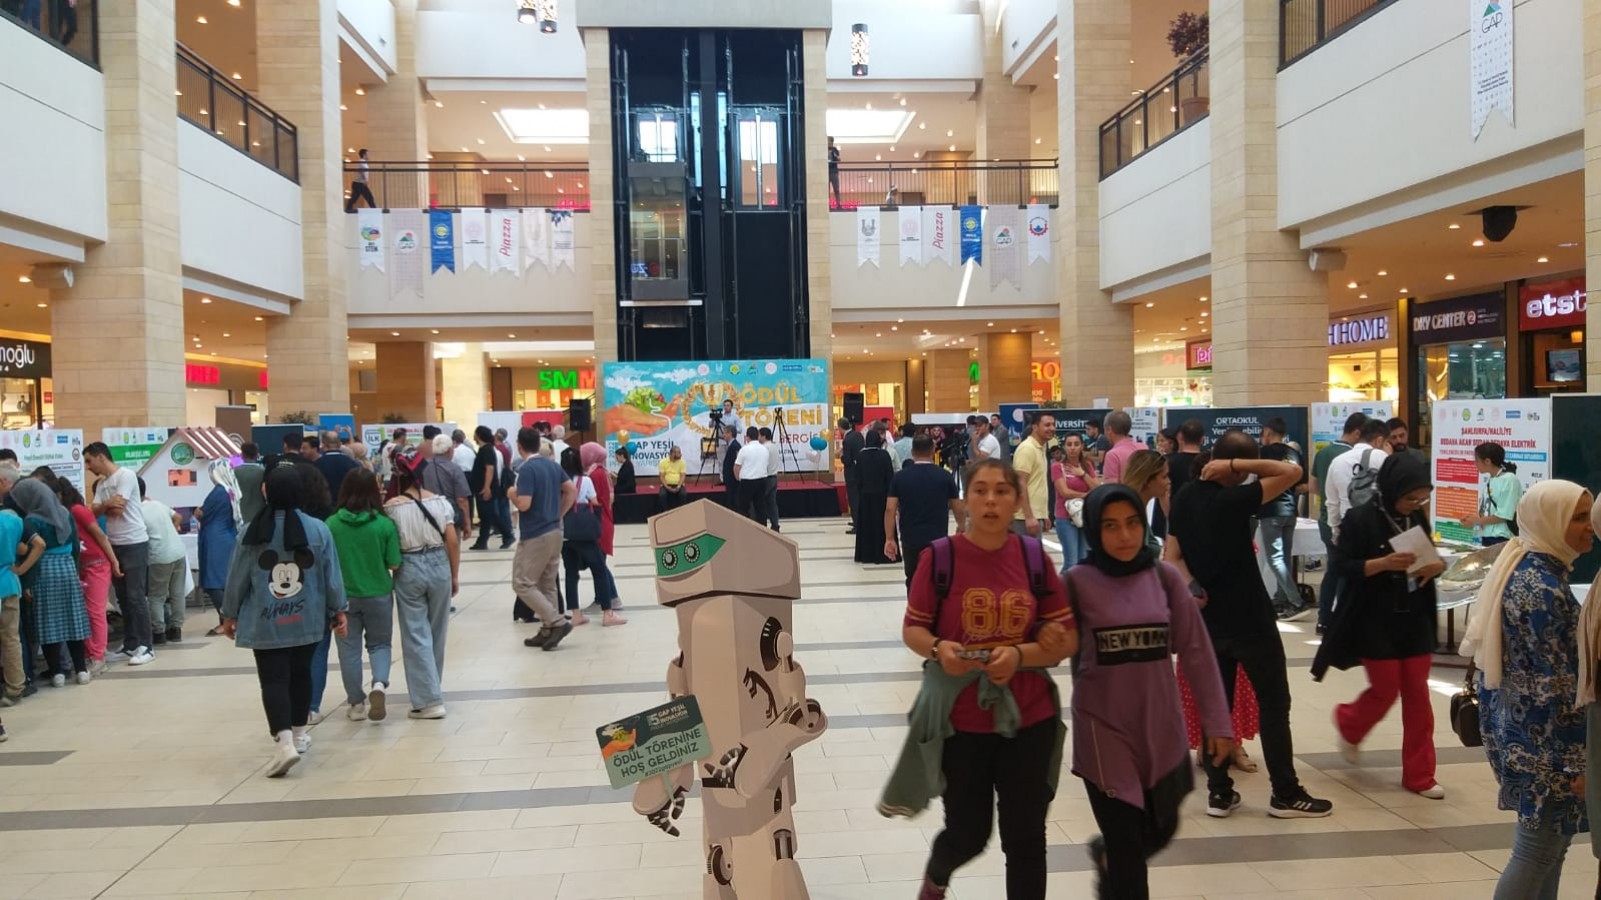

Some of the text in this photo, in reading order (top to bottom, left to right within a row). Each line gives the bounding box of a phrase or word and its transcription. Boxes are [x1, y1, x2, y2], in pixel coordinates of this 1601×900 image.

[1481, 12, 1504, 34] GAP
[499, 218, 512, 257] Piazza
[932, 211, 944, 250] Piazza
[1339, 316, 1388, 344] HOME
[1413, 315, 1431, 332] DRY
[1431, 310, 1466, 330] CENTER
[740, 382, 803, 404] ÖDÜL
[1215, 417, 1260, 426] ORTAOKUL
[636, 440, 648, 450] AP
[961, 587, 1031, 639] 86
[1100, 631, 1129, 650] NEW
[613, 729, 702, 768] ÖDÜL TÖRENİNE
[620, 742, 700, 778] HOŞ GELDİNİZ
